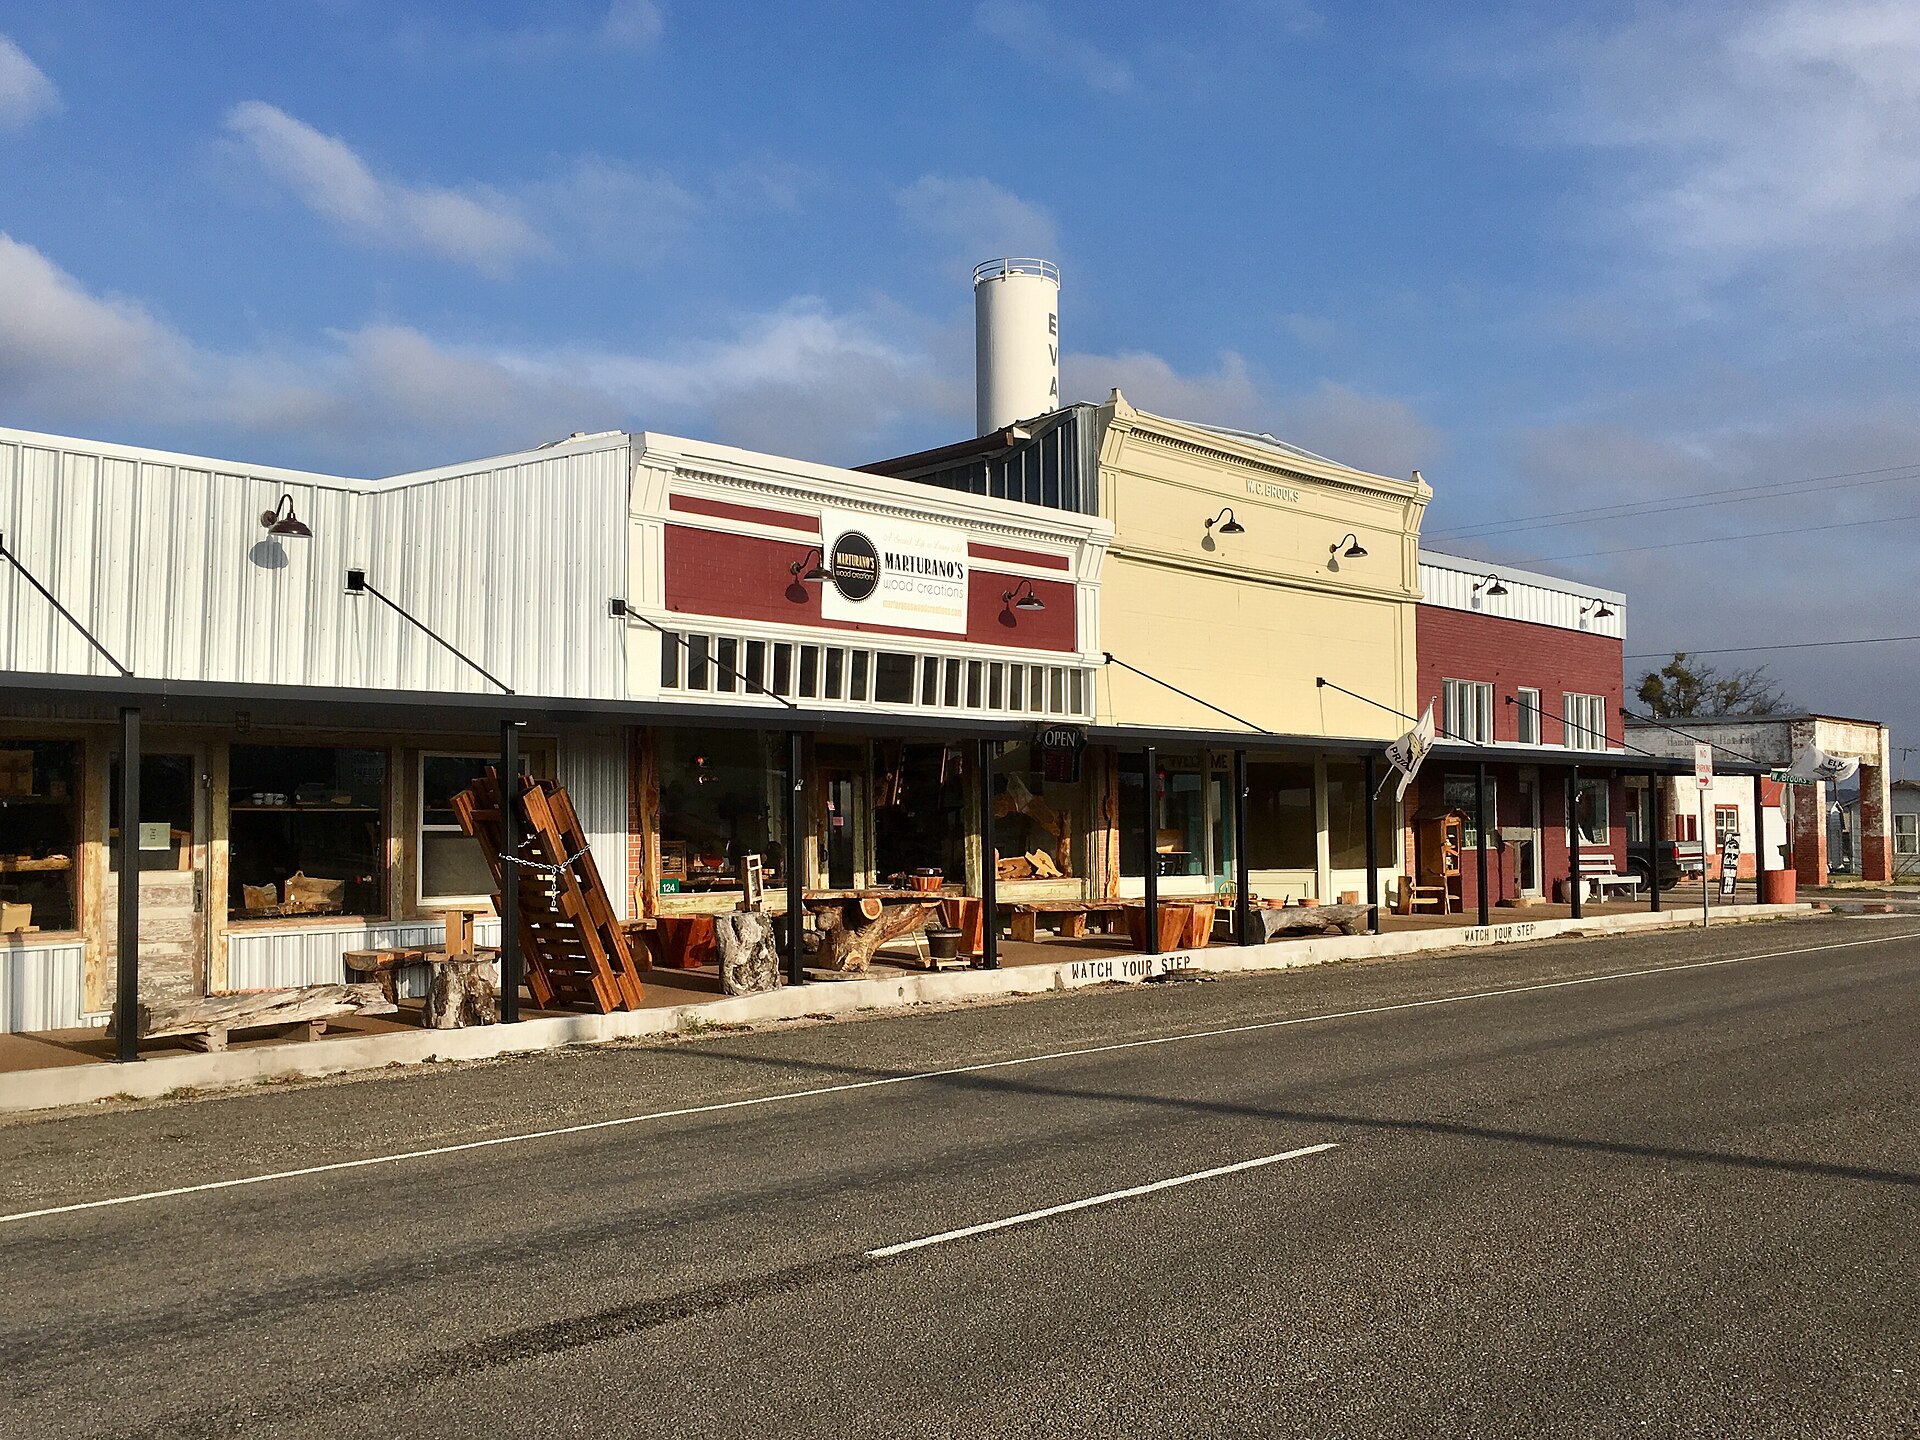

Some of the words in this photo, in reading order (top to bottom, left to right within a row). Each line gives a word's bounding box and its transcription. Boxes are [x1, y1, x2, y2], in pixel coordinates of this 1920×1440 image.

[836, 552, 875, 569] MARTURANO'S
[885, 552, 963, 580] MARTURANO'S
[836, 565, 852, 578] wood
[852, 567, 875, 581] creations
[883, 579, 914, 592] wood
[917, 583, 964, 599] creations
[1045, 730, 1076, 747] OPEN
[1699, 749, 1707, 758] NO
[1697, 764, 1712, 773] PARKING
[1828, 758, 1845, 768] ELK
[662, 883, 676, 893] 124
[1465, 928, 1490, 942] WATCH
[1494, 926, 1513, 940] YOUR
[1516, 923, 1536, 937] STEP
[1071, 961, 1113, 980] WATCH
[1121, 959, 1153, 977] YOUR
[1161, 955, 1191, 973] STEP
